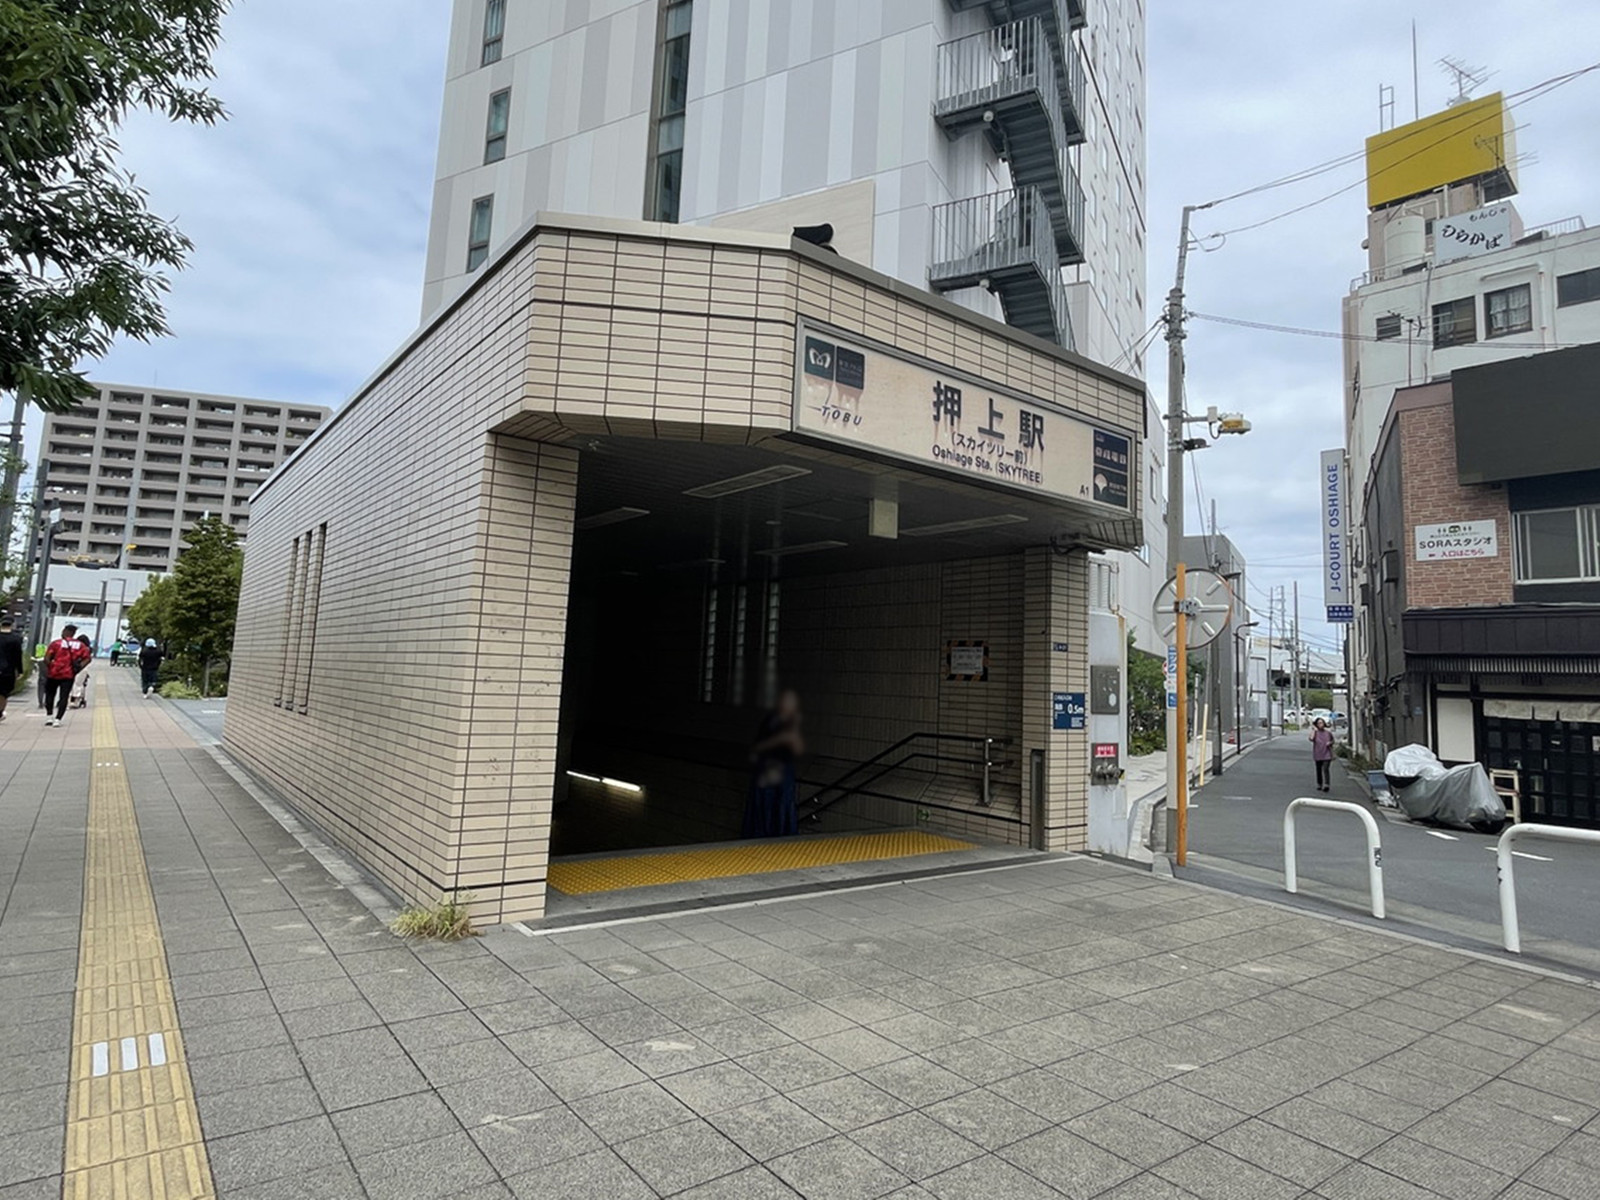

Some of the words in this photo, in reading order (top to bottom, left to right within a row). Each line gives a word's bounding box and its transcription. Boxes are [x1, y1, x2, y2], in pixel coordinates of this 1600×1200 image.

[822, 405, 862, 426] TOBU
[933, 381, 1044, 452] 押上駅
[932, 444, 973, 467] Oshiage
[975, 456, 993, 470] Sta.
[996, 462, 1044, 484] (SKYTREE)
[1079, 484, 1089, 496] A1
[1327, 464, 1340, 528] OSHIAGE
[1330, 533, 1341, 592] J-COURT
[1419, 537, 1492, 549] SORAスタジオ
